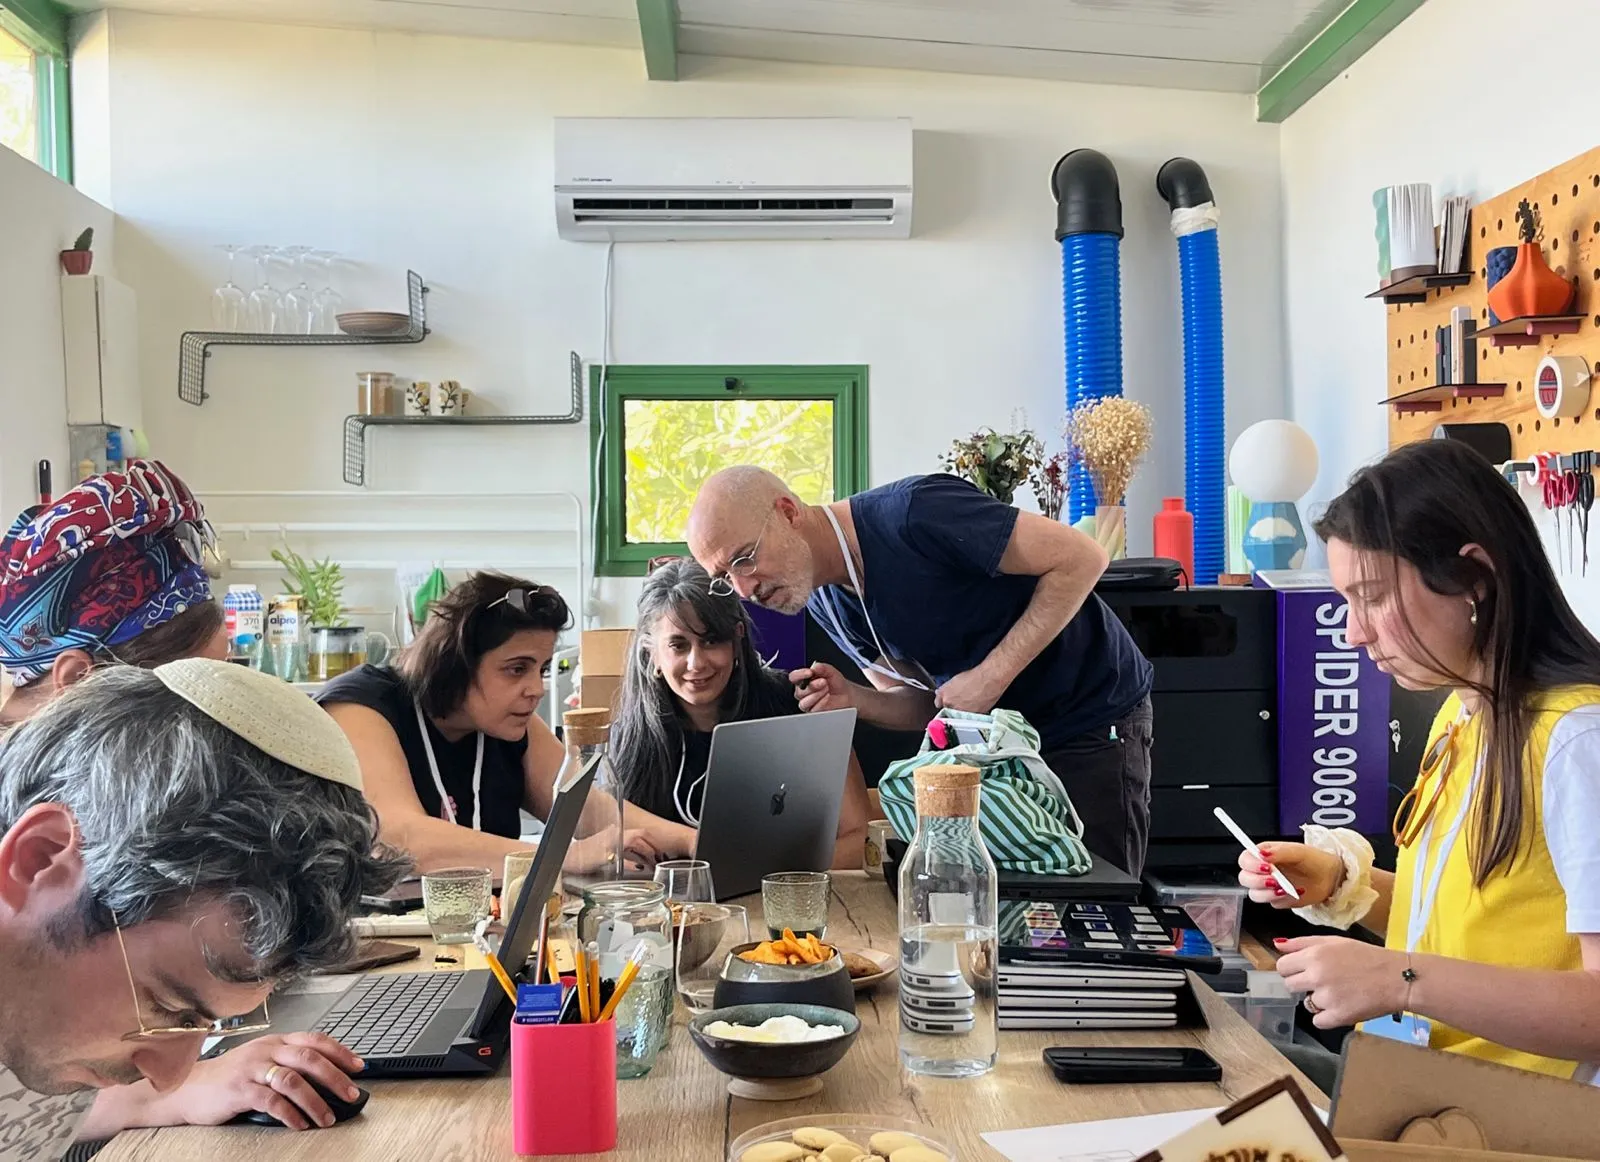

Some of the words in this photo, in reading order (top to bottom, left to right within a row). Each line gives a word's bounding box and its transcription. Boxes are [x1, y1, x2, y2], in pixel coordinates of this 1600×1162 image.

[270, 614, 297, 627] alpro
[1314, 602, 1359, 738] SPIDER
[1312, 747, 1357, 827] 9060
